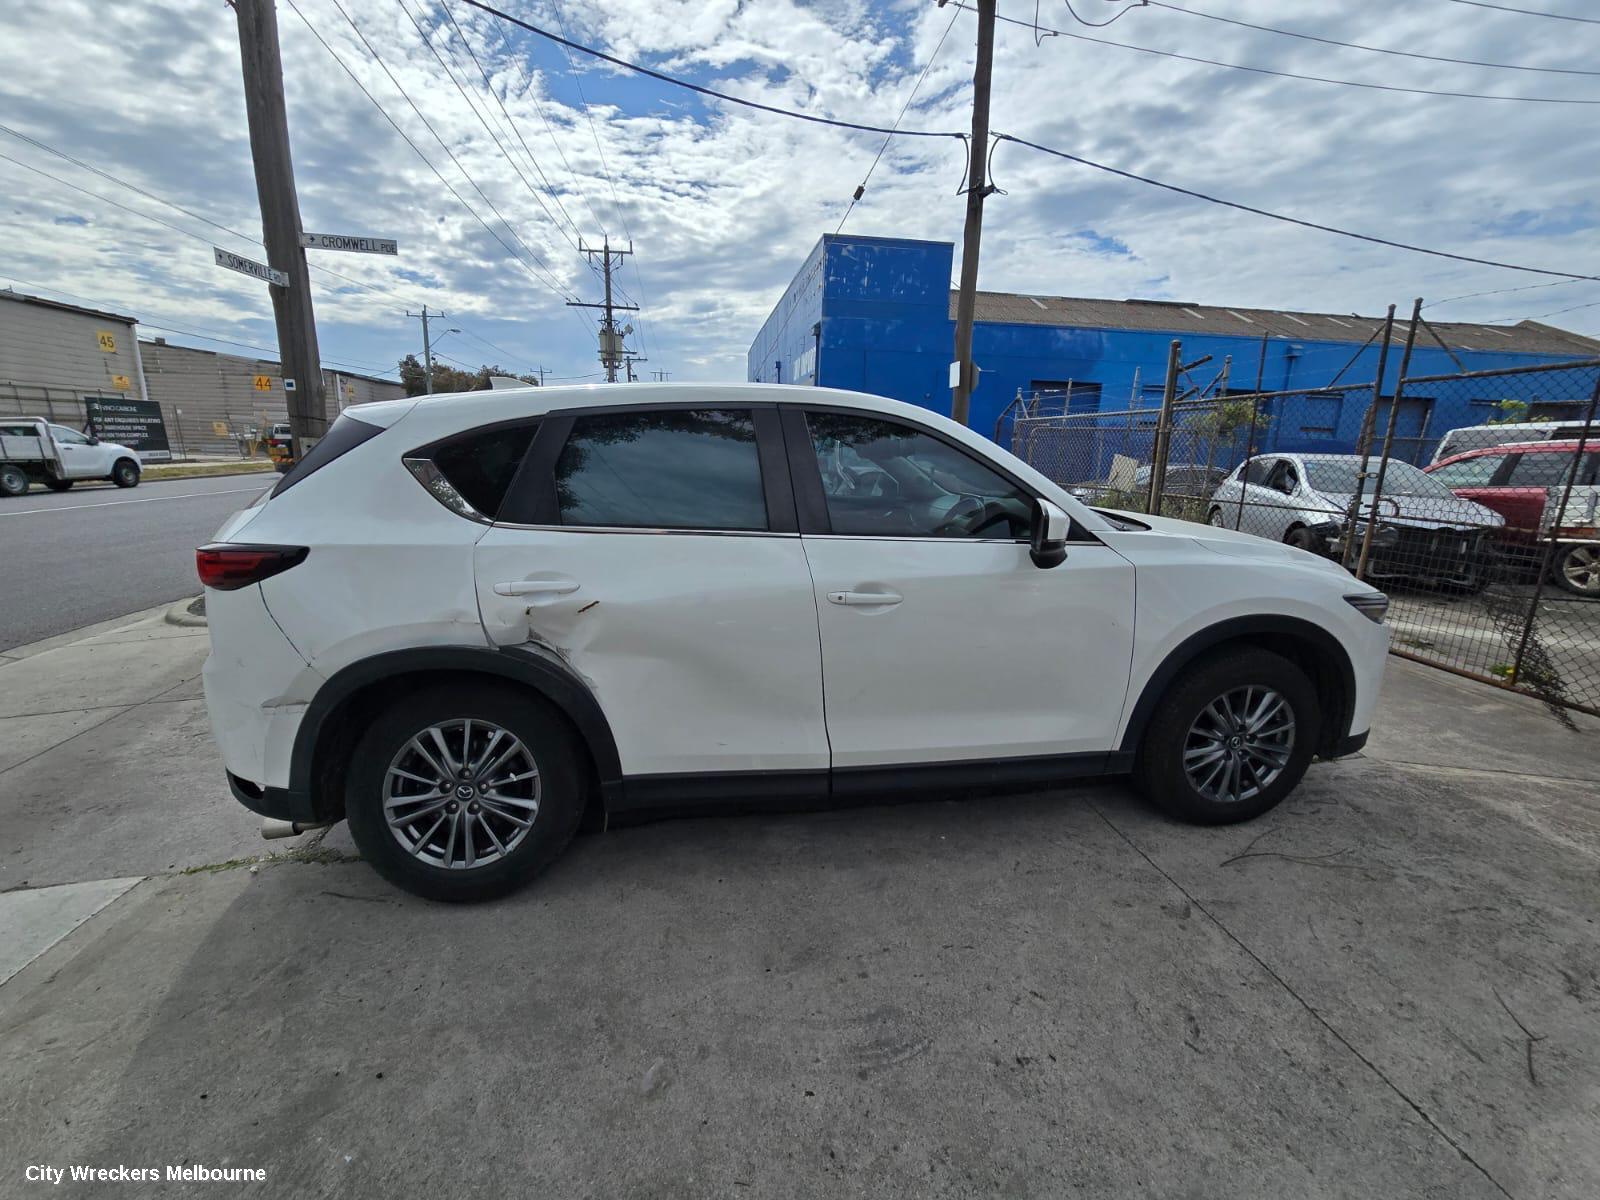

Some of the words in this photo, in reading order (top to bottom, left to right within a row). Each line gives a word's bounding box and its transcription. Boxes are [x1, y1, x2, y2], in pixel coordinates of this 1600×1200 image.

[321, 236, 379, 252] CROMWELL
[227, 254, 273, 281] SOMERVILLE
[100, 335, 114, 348] 45
[255, 377, 272, 391] 44
